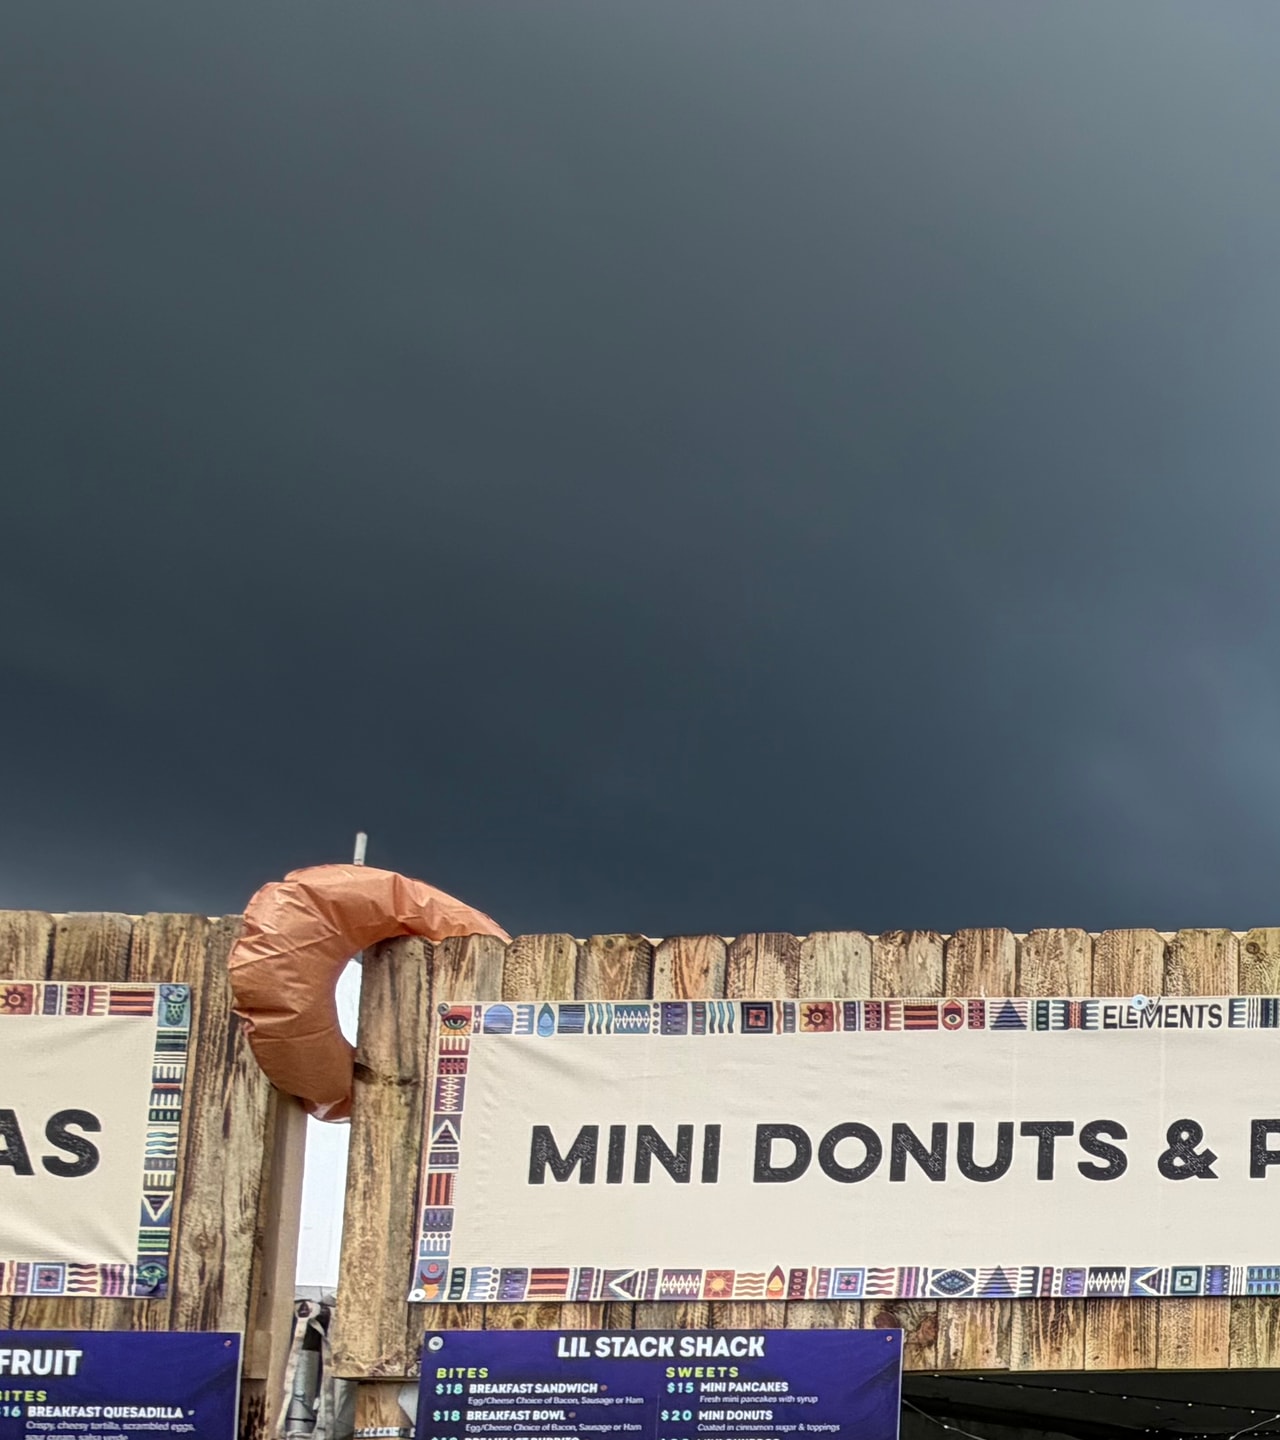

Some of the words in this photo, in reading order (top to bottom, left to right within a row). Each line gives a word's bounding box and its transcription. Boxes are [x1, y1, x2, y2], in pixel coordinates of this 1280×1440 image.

[1103, 1000, 1222, 1029] ELEMENTS
[527, 1124, 722, 1184] MINI
[753, 1119, 1128, 1183] DONUTS
[1157, 1118, 1219, 1180] &
[557, 1337, 591, 1358] LIL
[595, 1336, 675, 1358] STACK
[679, 1336, 765, 1358] SHACK
[0, 1349, 83, 1375] FRUIT
[436, 1367, 489, 1379] BITES
[665, 1366, 739, 1378] SWEETS
[435, 1383, 464, 1395] $18
[469, 1383, 534, 1394] BREAKFAST
[534, 1383, 598, 1394] SANDWICH
[667, 1382, 694, 1393] $15
[700, 1381, 727, 1393] MINI
[728, 1381, 789, 1393] PANCAKES
[0, 1406, 21, 1417] 16
[27, 1406, 102, 1417] BREAKFAST
[103, 1406, 184, 1419] QUESADILLA
[432, 1411, 461, 1422] $18
[466, 1410, 531, 1421] BREAKFAST
[532, 1410, 566, 1421] BOWL
[660, 1410, 692, 1422] $20
[698, 1410, 724, 1421] MINI
[726, 1410, 773, 1421] DONUTS
